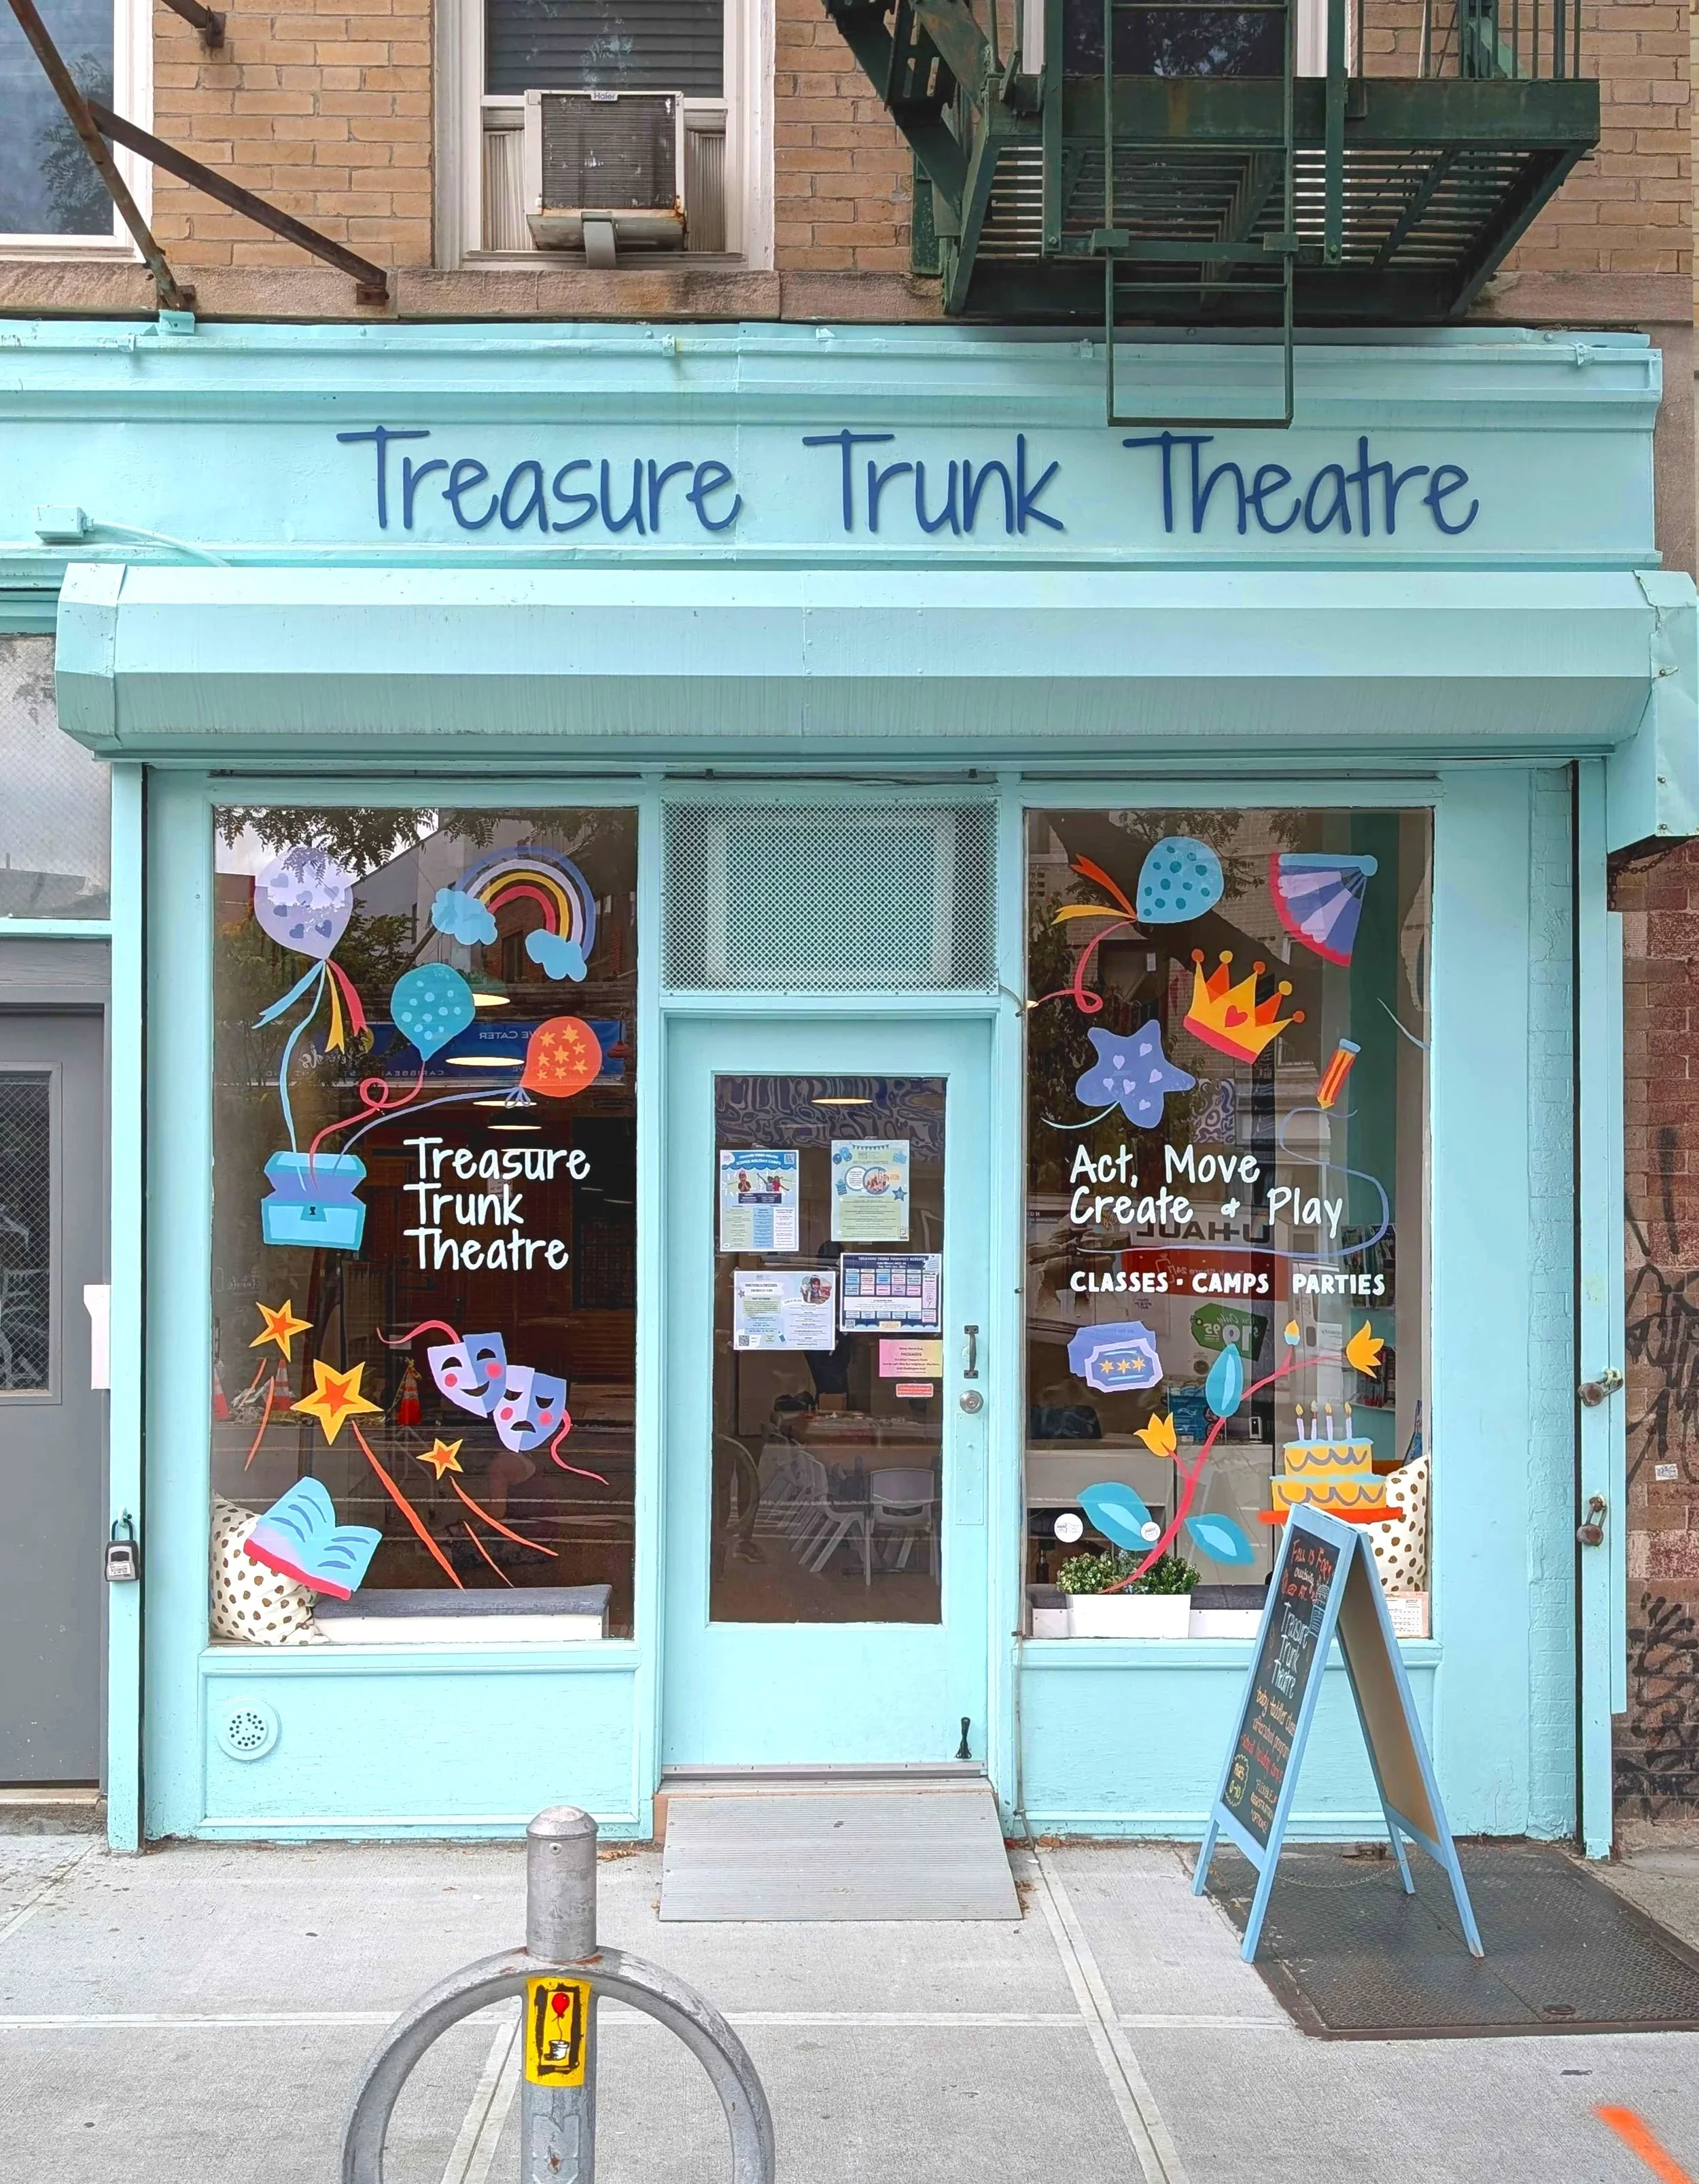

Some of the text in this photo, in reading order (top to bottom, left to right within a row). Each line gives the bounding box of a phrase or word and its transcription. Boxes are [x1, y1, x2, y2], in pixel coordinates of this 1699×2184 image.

[593, 92, 616, 101] Haier
[336, 425, 1479, 535] Treasure Trunk Theatre
[404, 1138, 590, 1180] Treasure
[1070, 1145, 1259, 1189] Act, Move
[404, 1182, 523, 1225] Trunk
[1070, 1186, 1193, 1224] Create
[1267, 1187, 1342, 1239] Play
[404, 1227, 568, 1270] Theatre
[1070, 1271, 1384, 1295] CLASSES CAMPS PARTIES
[1281, 1601, 1311, 1647] Treasure
[1279, 1634, 1299, 1672] Trunk
[1272, 1659, 1295, 1697] Theatre
